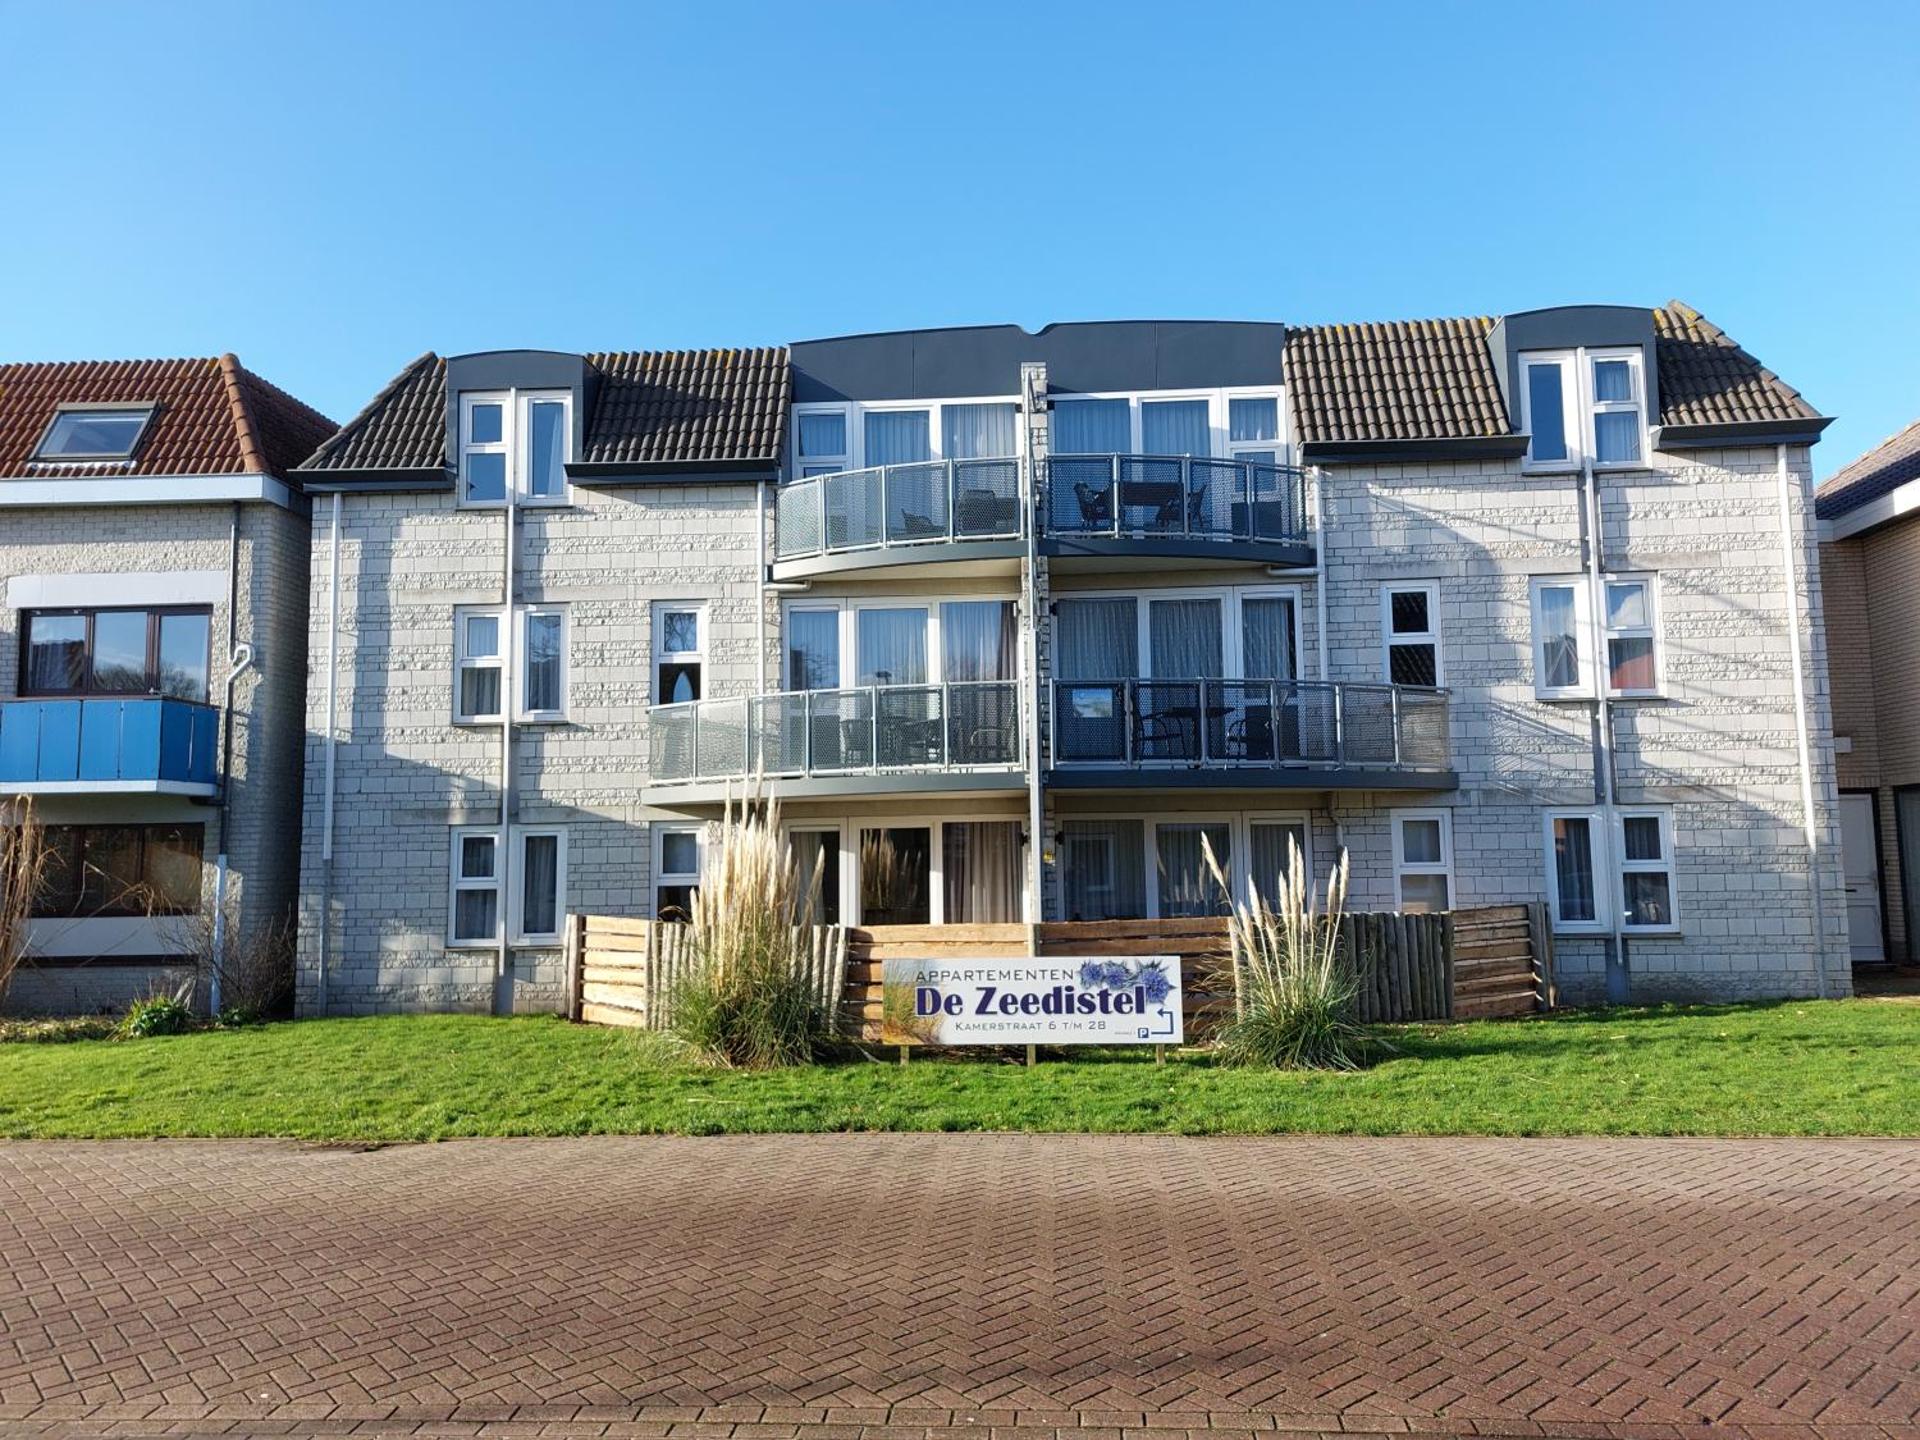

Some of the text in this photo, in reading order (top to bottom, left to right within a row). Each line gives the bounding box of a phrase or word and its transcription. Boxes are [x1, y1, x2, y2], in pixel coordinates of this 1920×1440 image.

[916, 969, 1074, 981] APPARTEMENTEN
[916, 985, 1145, 1015] De Zeedistel
[955, 1021, 1106, 1030] KAMERSTRAAT 6 T/M 28
